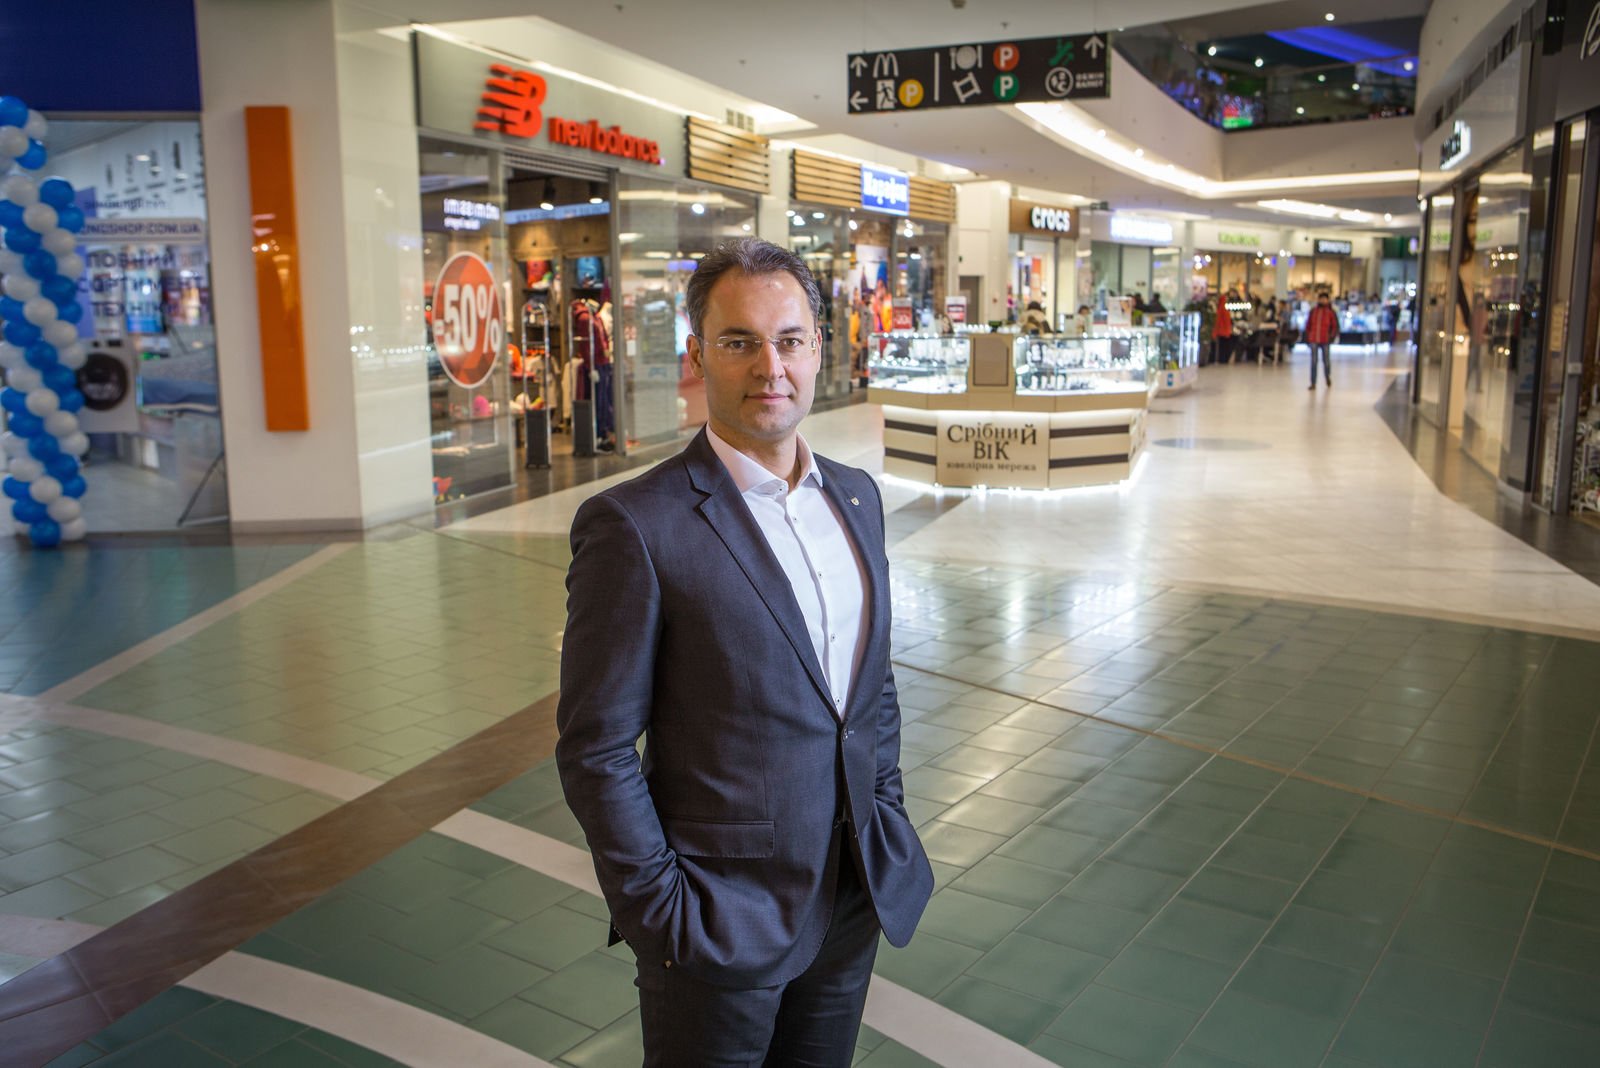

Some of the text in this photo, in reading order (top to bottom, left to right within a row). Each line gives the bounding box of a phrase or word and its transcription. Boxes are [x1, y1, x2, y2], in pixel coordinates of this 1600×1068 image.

[1000, 46, 1014, 68] P
[904, 85, 920, 104] P
[1000, 75, 1014, 97] P
[1031, 207, 1071, 232] crocs
[946, 422, 1038, 446] Срібний
